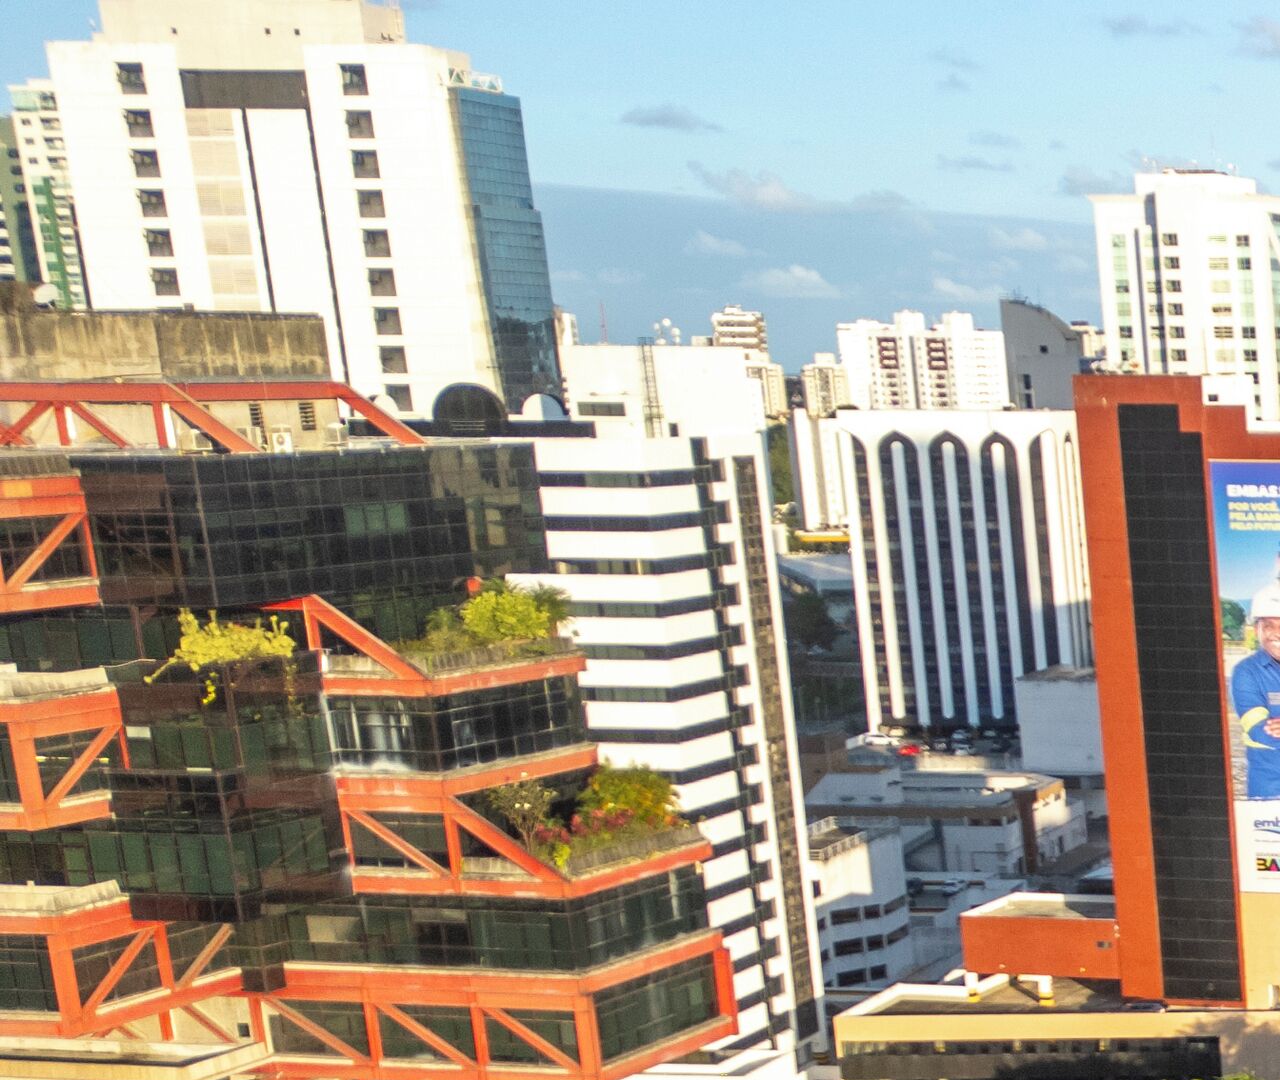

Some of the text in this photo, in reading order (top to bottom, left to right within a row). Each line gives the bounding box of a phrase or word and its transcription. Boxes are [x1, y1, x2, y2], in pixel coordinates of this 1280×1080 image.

[1228, 501, 1250, 511] POR
[1229, 511, 1256, 521] PELA
[1230, 521, 1255, 530] PELO
